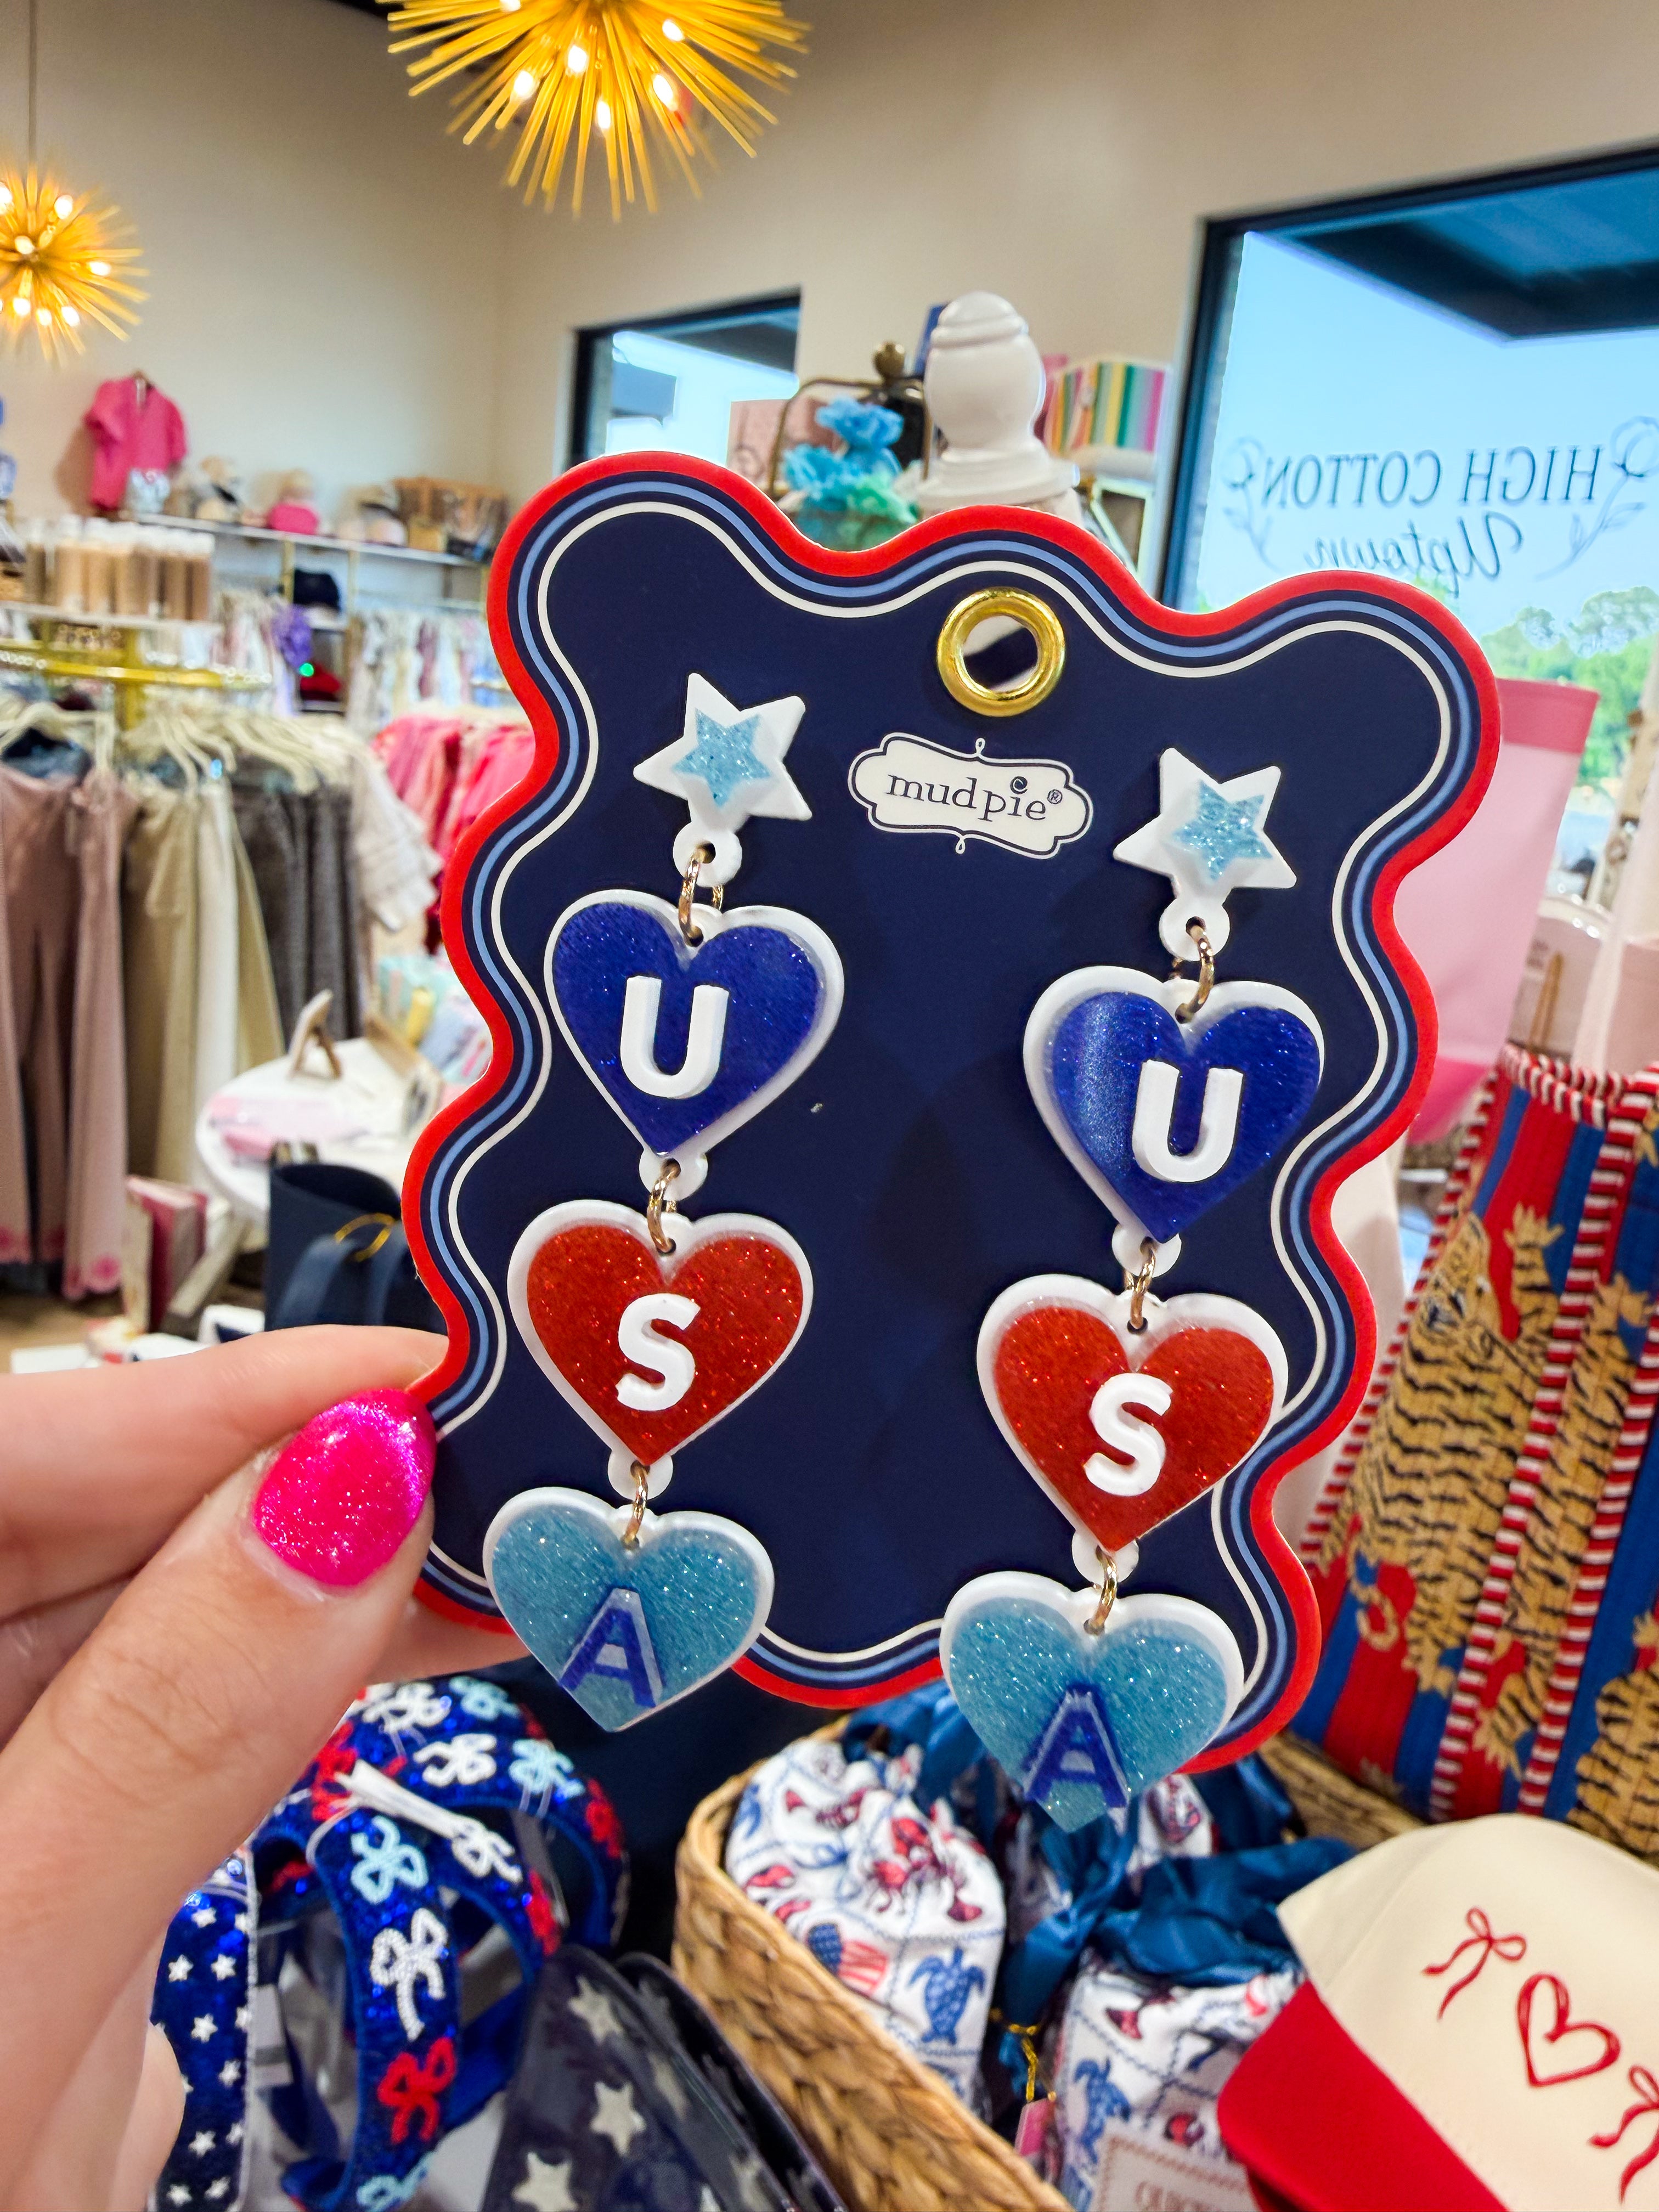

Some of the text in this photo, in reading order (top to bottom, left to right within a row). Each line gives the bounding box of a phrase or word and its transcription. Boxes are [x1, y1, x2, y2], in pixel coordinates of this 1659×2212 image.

[620, 975, 730, 1099] U
[1131, 1059, 1244, 1183] U
[615, 1293, 701, 1412] S
[1082, 1372, 1173, 1497] S
[558, 1587, 663, 1709] A
[1023, 1686, 1130, 1809] A
